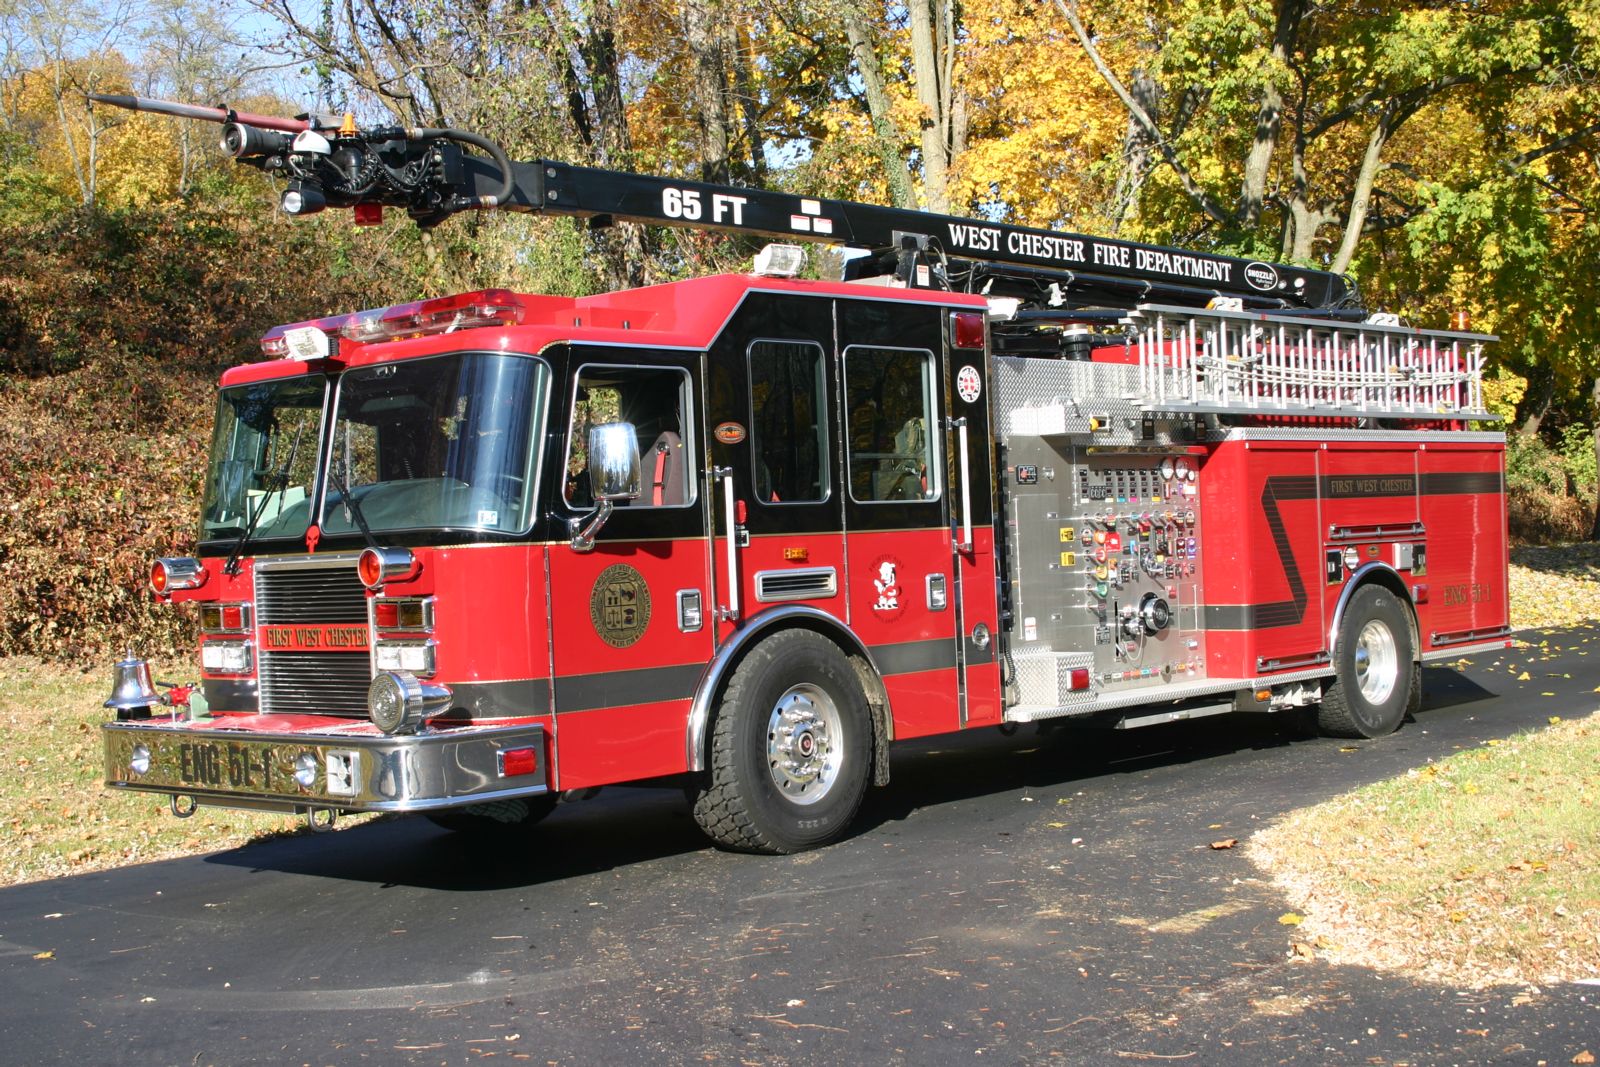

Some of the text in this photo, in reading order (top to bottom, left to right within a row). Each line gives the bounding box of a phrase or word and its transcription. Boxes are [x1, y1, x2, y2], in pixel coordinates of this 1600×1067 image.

[662, 187, 748, 226] 65 FT
[948, 223, 1232, 282] WEST CHESTER FIRE DEPARTMENT
[1248, 269, 1274, 280] SNOZZLE
[1330, 478, 1413, 493] FIRST WEST CHESTER
[1443, 584, 1468, 607] ENG
[266, 627, 368, 648] FIRST WEST CHESTER
[180, 743, 271, 789] ENG 51-1
